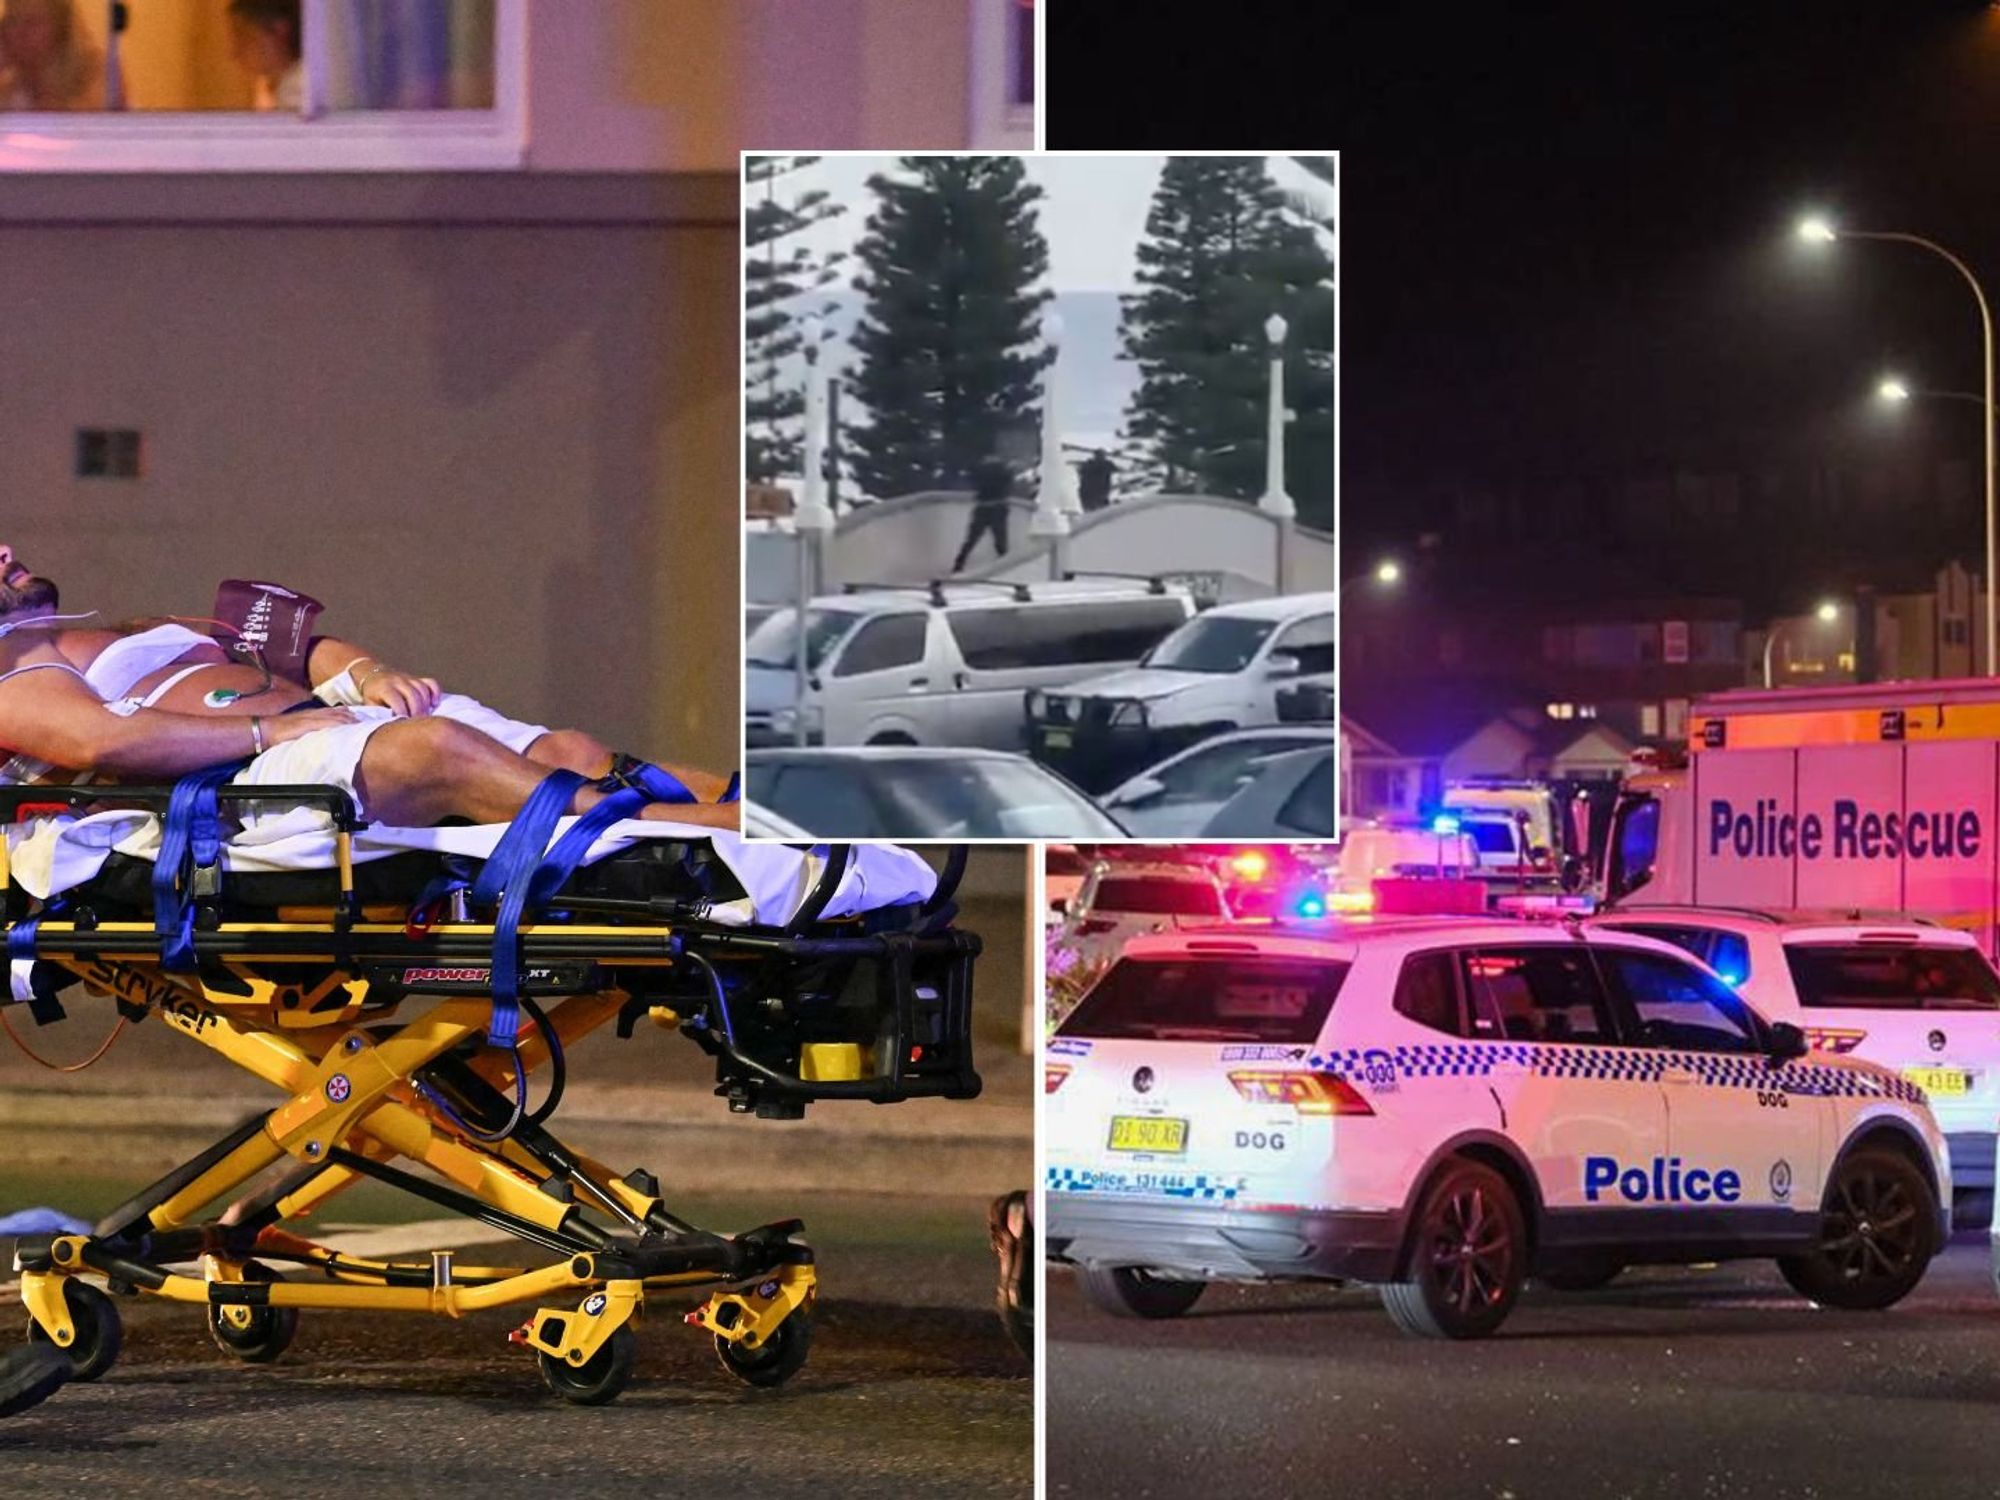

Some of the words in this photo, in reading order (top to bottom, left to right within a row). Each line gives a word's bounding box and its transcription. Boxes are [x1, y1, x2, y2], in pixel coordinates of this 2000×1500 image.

[1709, 798, 1823, 858] Police
[1833, 799, 1981, 859] Rescue
[402, 967, 491, 985] power
[527, 968, 551, 978] XT
[87, 958, 218, 1034] stryker
[1757, 1091, 1789, 1109] DOG
[1235, 1131, 1285, 1150] DOG
[1081, 1170, 1127, 1185] Police
[1582, 1156, 1742, 1202] Police
